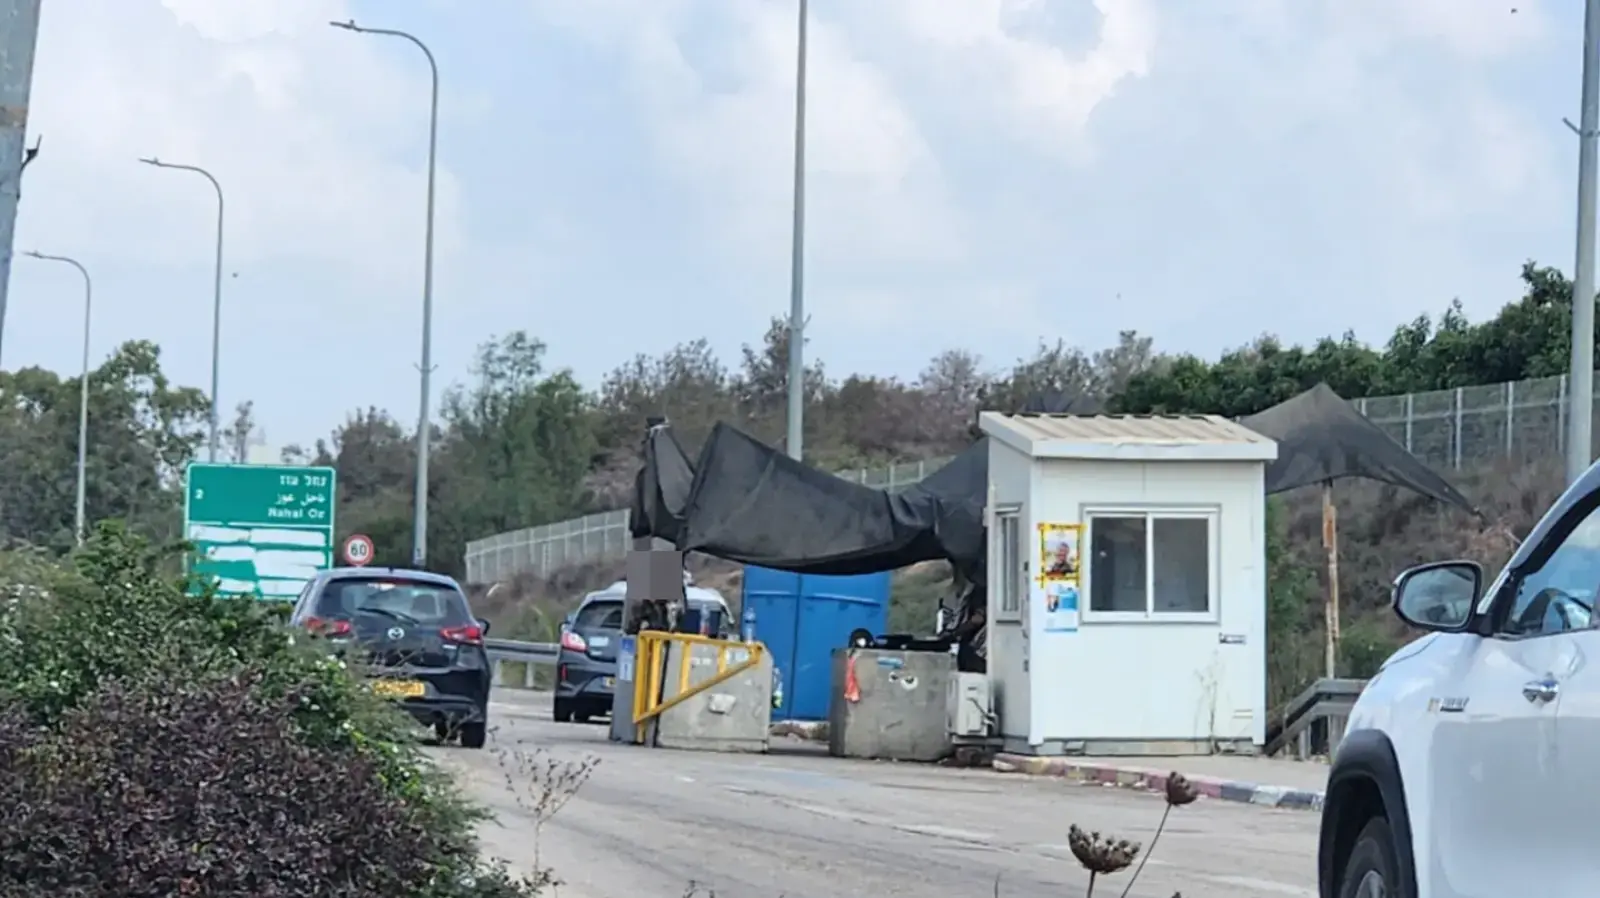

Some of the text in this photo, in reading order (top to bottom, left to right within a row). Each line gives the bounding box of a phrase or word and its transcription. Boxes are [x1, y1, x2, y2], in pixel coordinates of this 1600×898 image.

[280, 475, 327, 487] נחל עוז
[268, 508, 325, 518] Nahal Oz
[351, 543, 367, 557] 60
